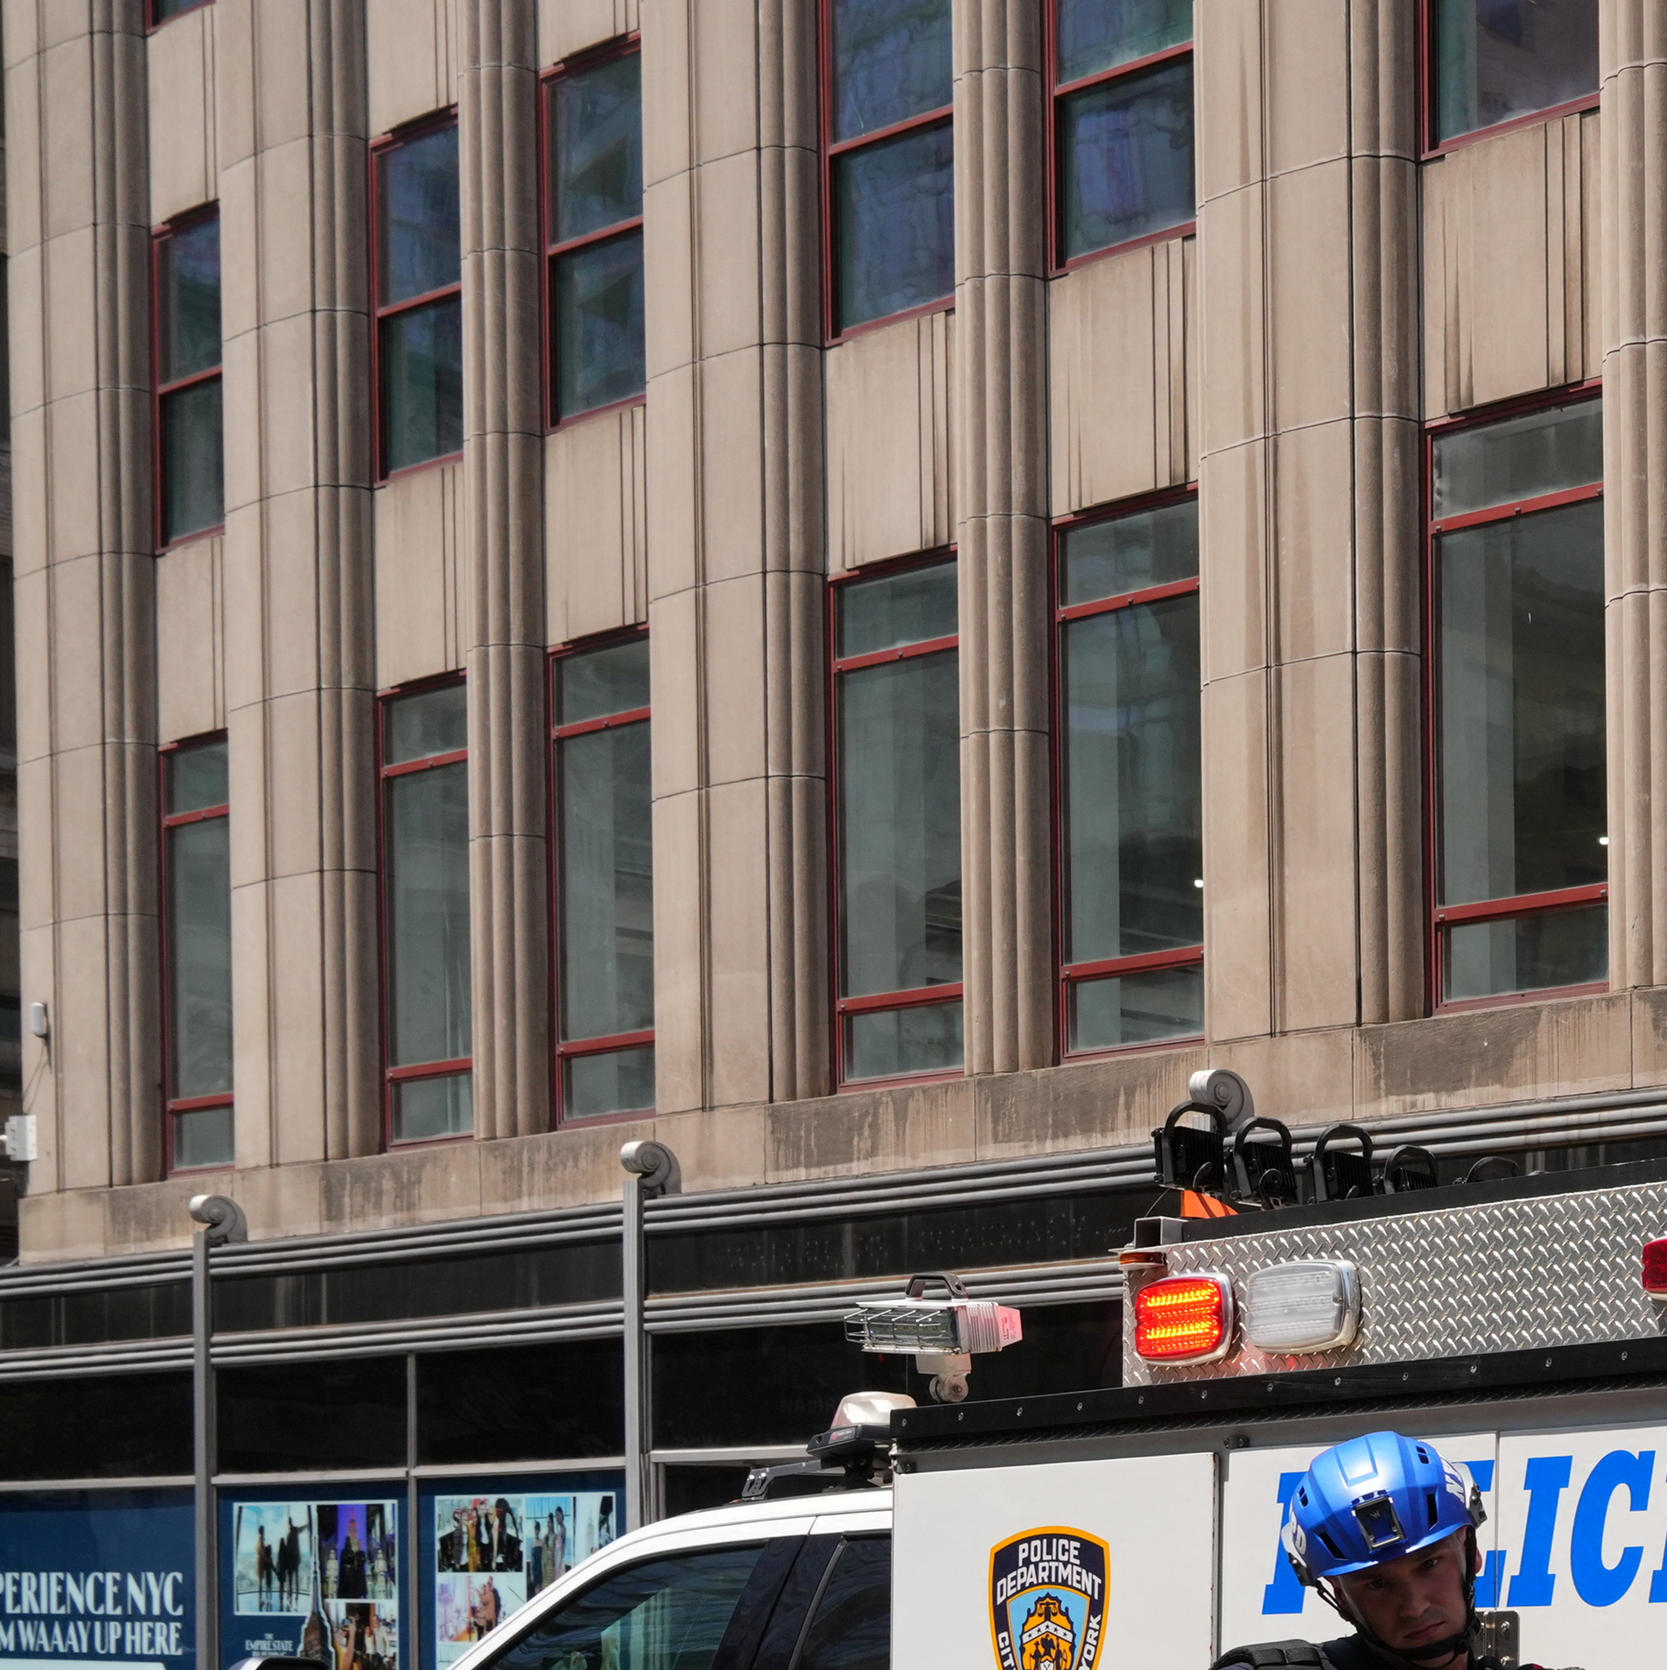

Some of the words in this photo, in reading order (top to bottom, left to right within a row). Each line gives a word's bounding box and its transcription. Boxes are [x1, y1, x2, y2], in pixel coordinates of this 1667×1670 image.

[1018, 1538, 1081, 1567] POLICE
[127, 1572, 184, 1616] NYC
[996, 1561, 1102, 1606] DEPARTMENT
[17, 1620, 91, 1653] WAAAY
[94, 1621, 122, 1654] UP
[125, 1622, 183, 1655] HERE
